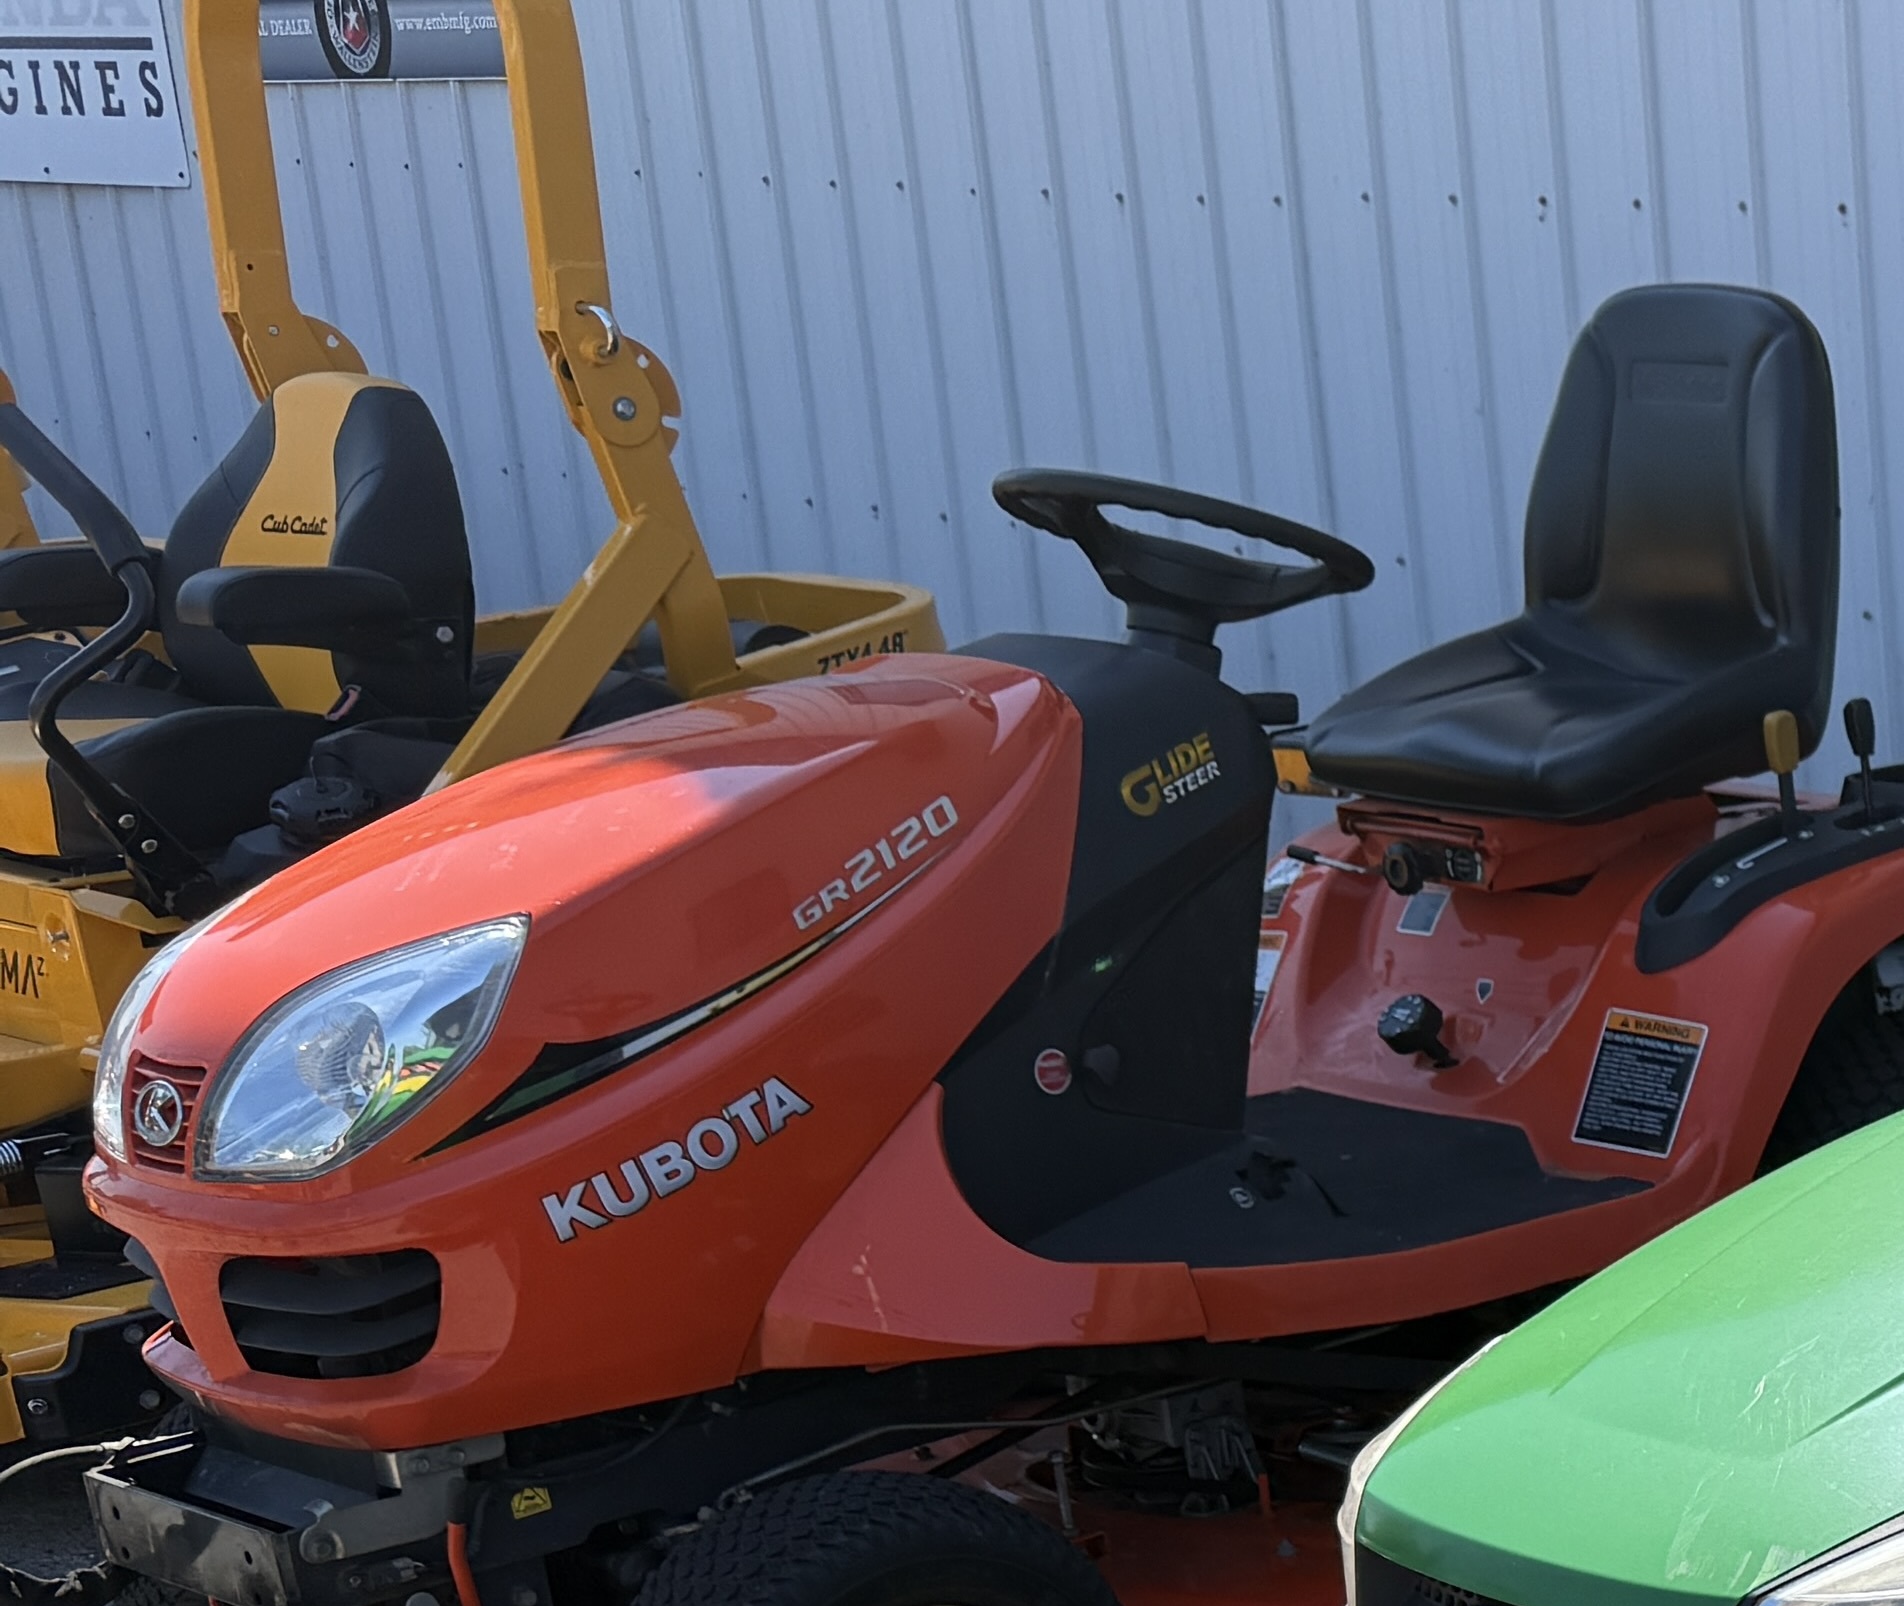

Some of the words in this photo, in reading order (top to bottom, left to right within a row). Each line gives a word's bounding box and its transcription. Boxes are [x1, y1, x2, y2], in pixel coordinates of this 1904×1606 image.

[269, 18, 313, 36] DEALER
[394, 11, 499, 34] www.embmfg.com
[261, 514, 289, 533] Cub
[290, 515, 328, 535] Cadet
[1121, 732, 1215, 817] GLIDE
[1163, 760, 1221, 804] STEER
[792, 795, 958, 930] GR2120
[1633, 1018, 1690, 1039] WARNING
[541, 1075, 815, 1244] KUBOTA
